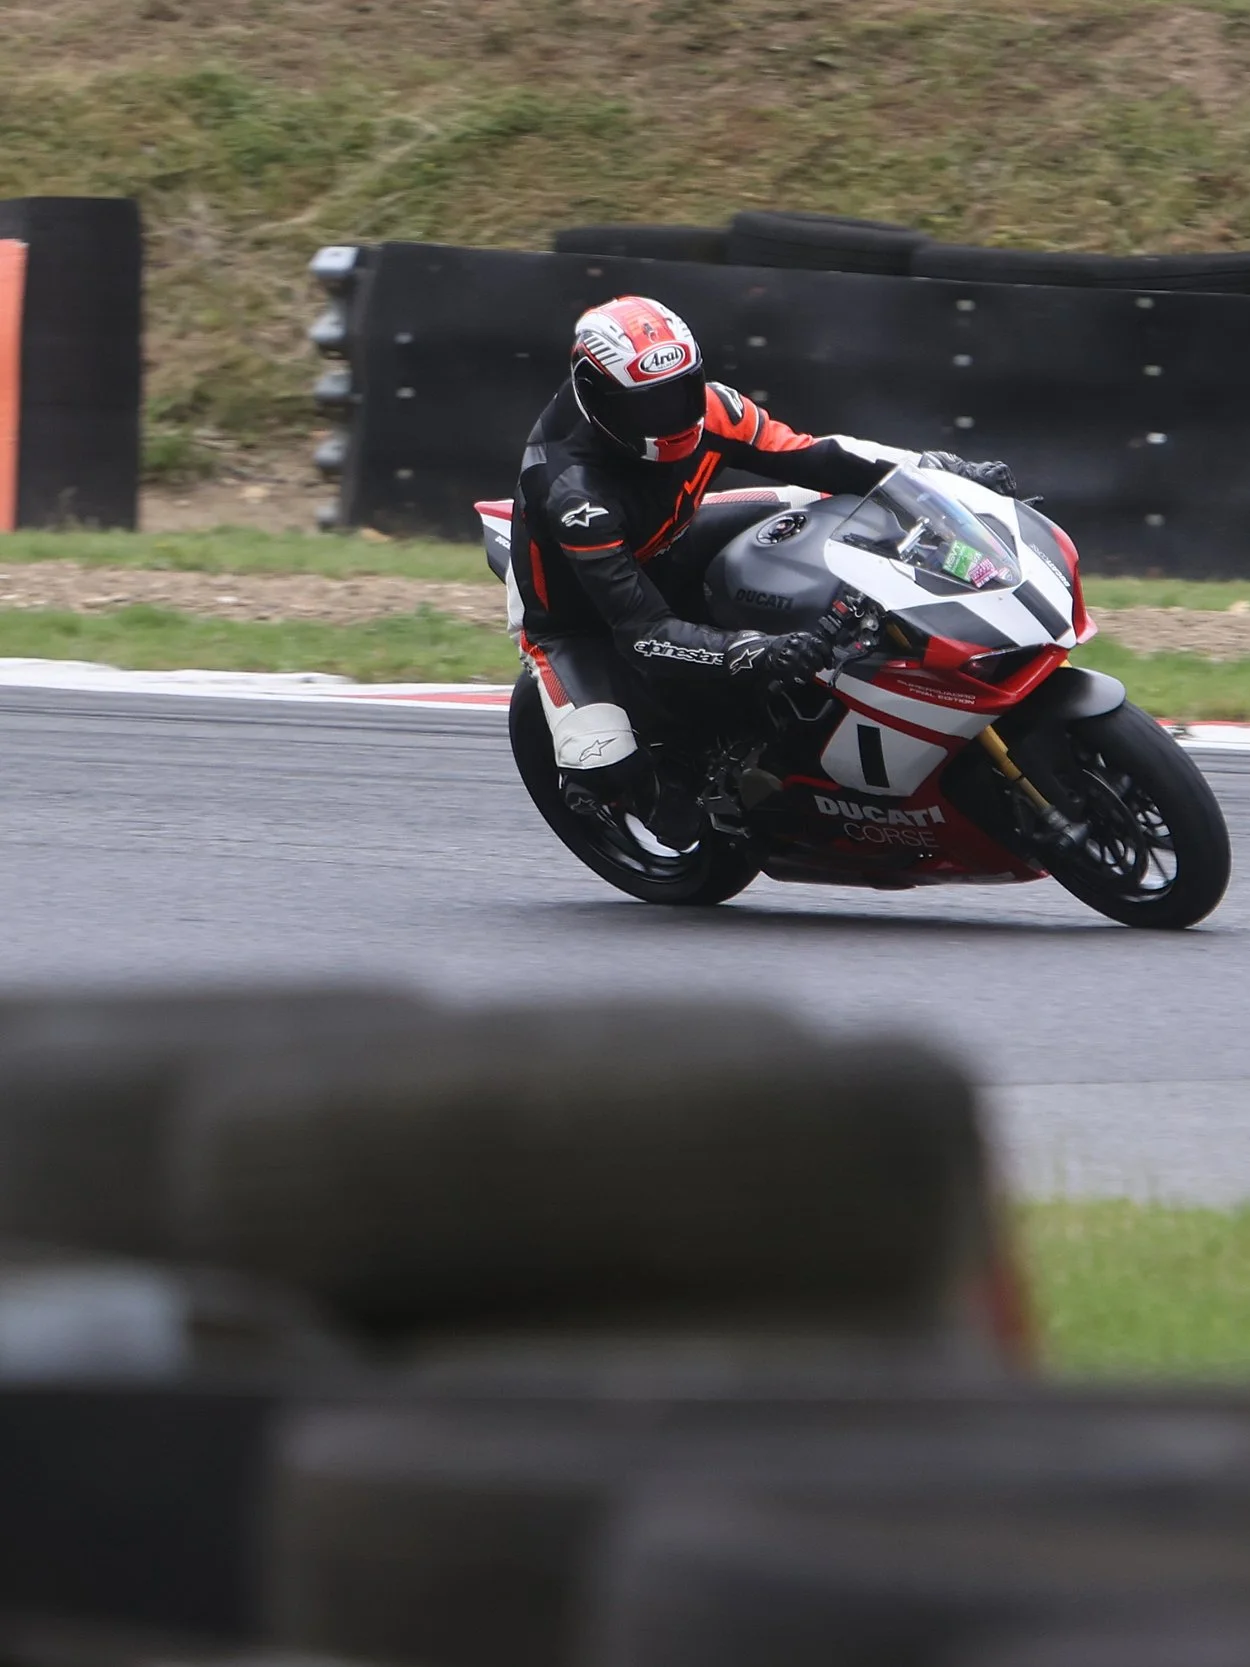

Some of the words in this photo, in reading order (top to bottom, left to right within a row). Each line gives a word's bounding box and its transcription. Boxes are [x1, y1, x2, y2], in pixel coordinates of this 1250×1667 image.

[645, 347, 679, 370] Arai
[736, 588, 795, 610] DUCATI
[634, 640, 725, 665] alpinestars
[938, 695, 975, 705] EDITION
[857, 724, 890, 788] 1
[814, 795, 945, 827] DUCATI
[843, 822, 940, 848] CORSE
